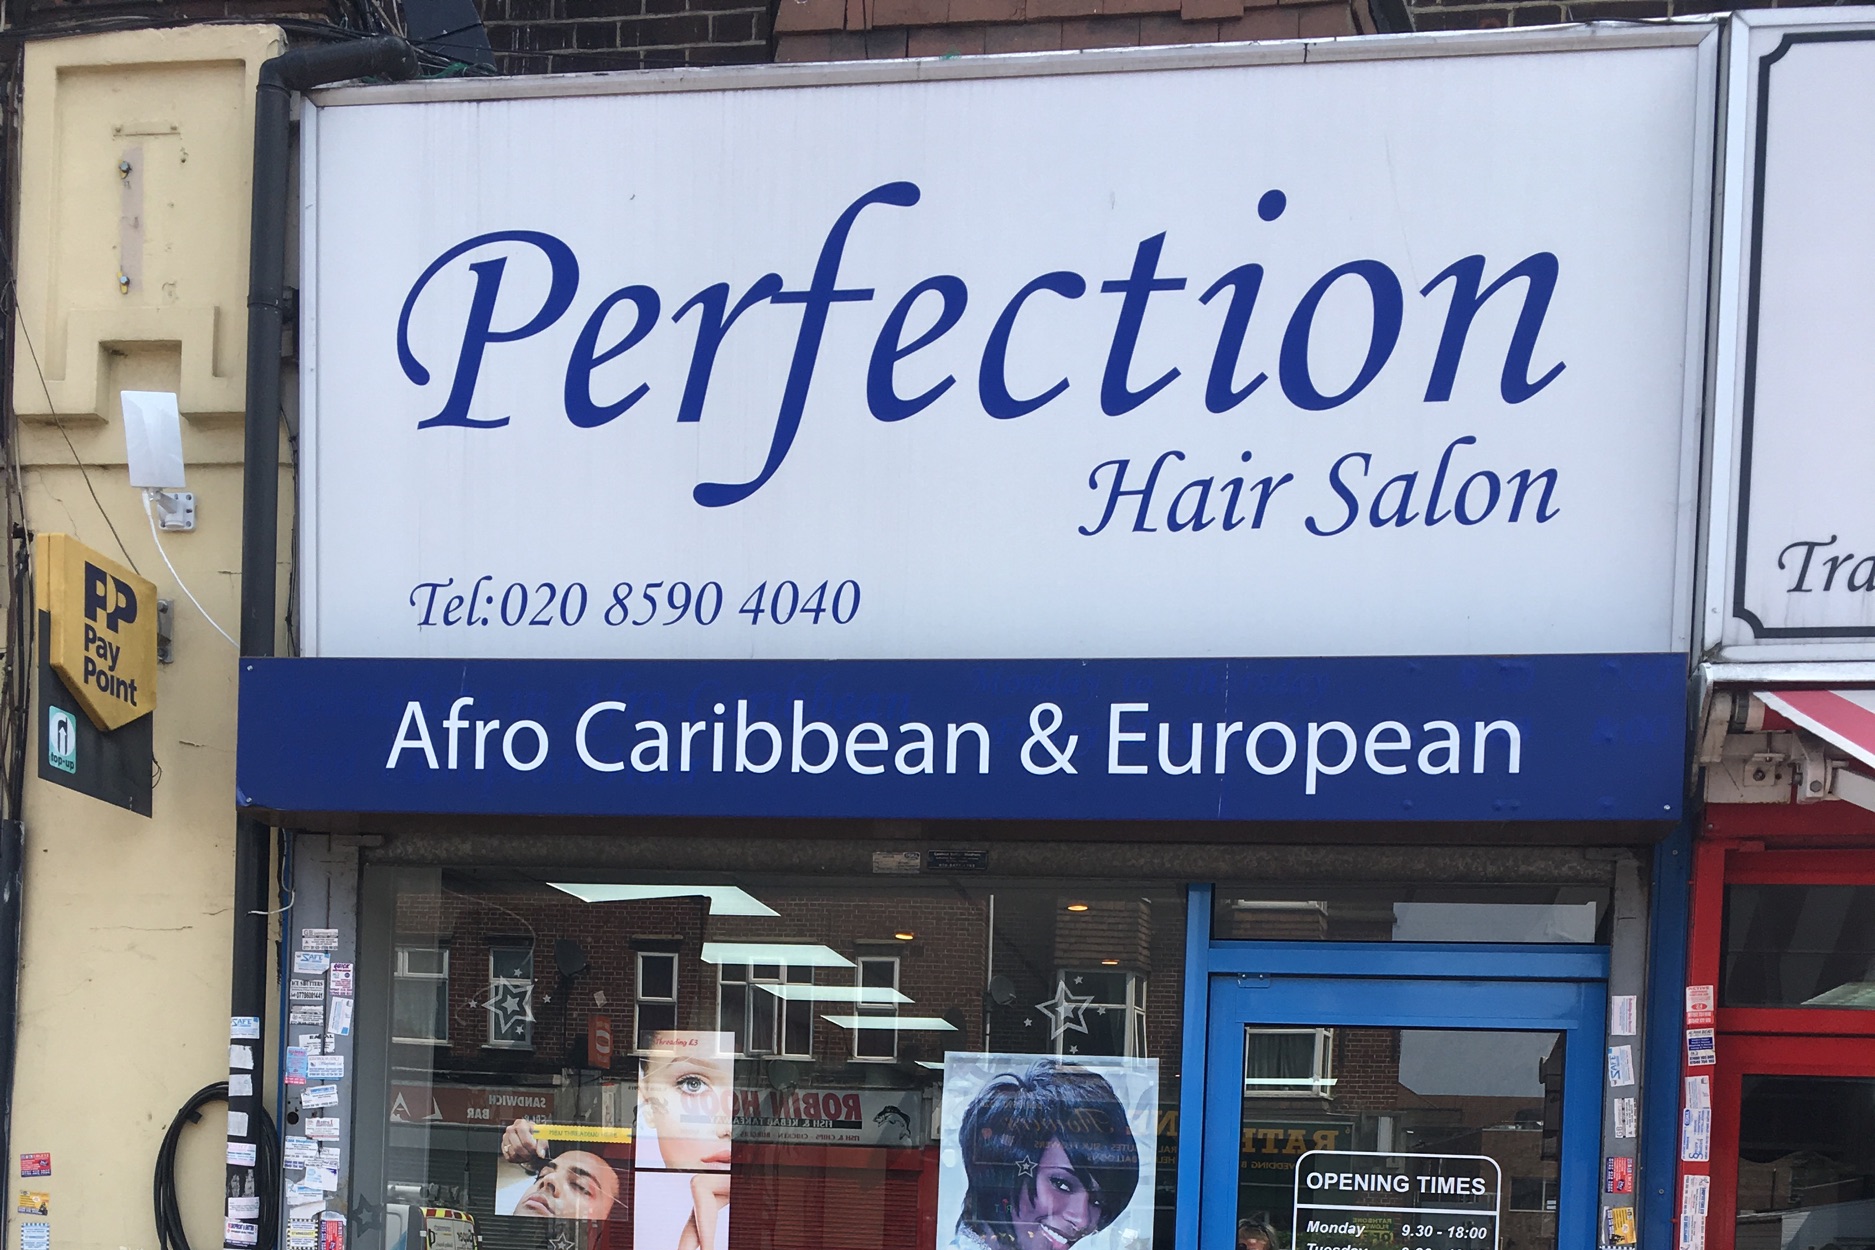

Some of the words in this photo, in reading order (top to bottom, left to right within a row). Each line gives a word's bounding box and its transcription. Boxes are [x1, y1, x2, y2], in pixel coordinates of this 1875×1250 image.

[396, 180, 1566, 508] Perfection
[1078, 450, 1294, 537] Hair
[1304, 435, 1561, 537] Salon
[1777, 533, 1875, 593] Tra
[409, 575, 587, 626] Tel:020
[603, 580, 723, 626] 8590
[738, 579, 861, 626] 4040
[84, 622, 120, 671] Pay
[84, 655, 138, 707] Point
[51, 751, 76, 770] top-up
[386, 696, 549, 771] Afro
[575, 699, 990, 775] Caribbean
[1020, 702, 1084, 775] &
[1108, 702, 1521, 795] European
[655, 1037, 686, 1048] Threading
[1306, 1172, 1410, 1193] OPENING
[1417, 1176, 1486, 1196] TIMES
[1306, 1220, 1365, 1237] Monday
[1401, 1225, 1433, 1238] 9.30
[1447, 1227, 1487, 1240] 18:00
